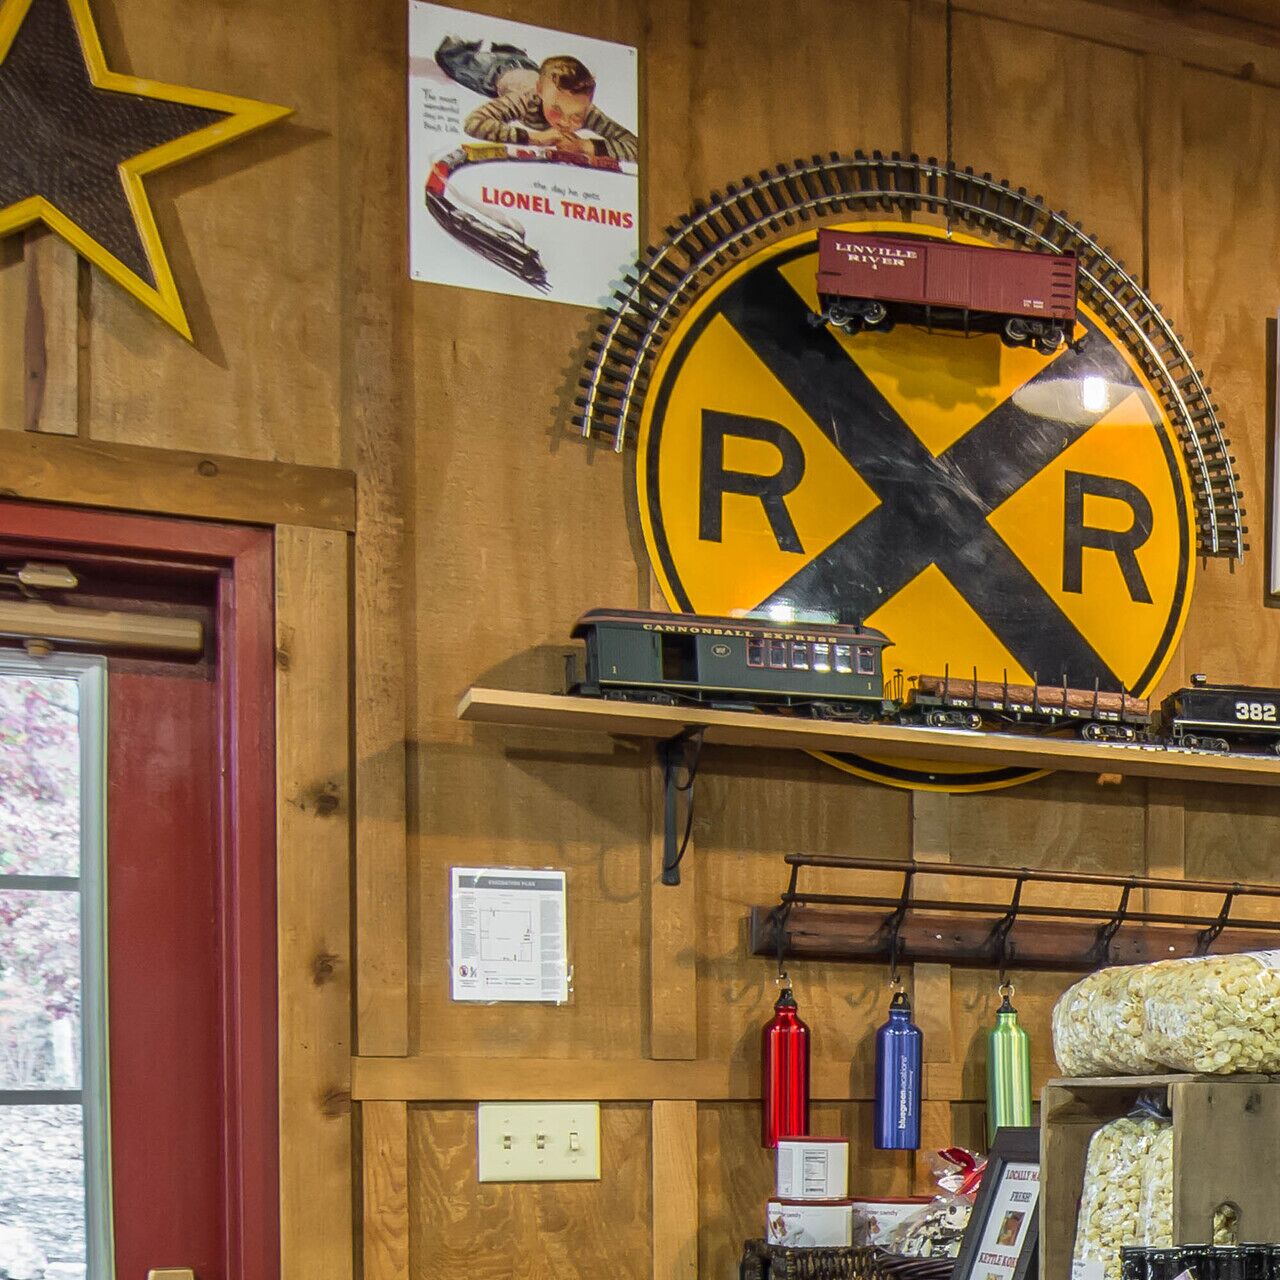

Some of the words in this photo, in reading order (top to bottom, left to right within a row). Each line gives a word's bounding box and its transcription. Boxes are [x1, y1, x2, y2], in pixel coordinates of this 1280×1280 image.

[551, 185, 566, 197] day
[568, 188, 578, 197] he
[583, 191, 600, 201] gets
[482, 186, 555, 216] LIONEL
[561, 200, 633, 229] TRAINS
[835, 243, 917, 259] LINVILLE
[848, 254, 905, 266] RIVER
[699, 408, 806, 555] R
[1062, 470, 1154, 605] R
[643, 624, 753, 638] CANNONBALL
[762, 632, 838, 643] EXPRESS
[1234, 702, 1277, 722] 382
